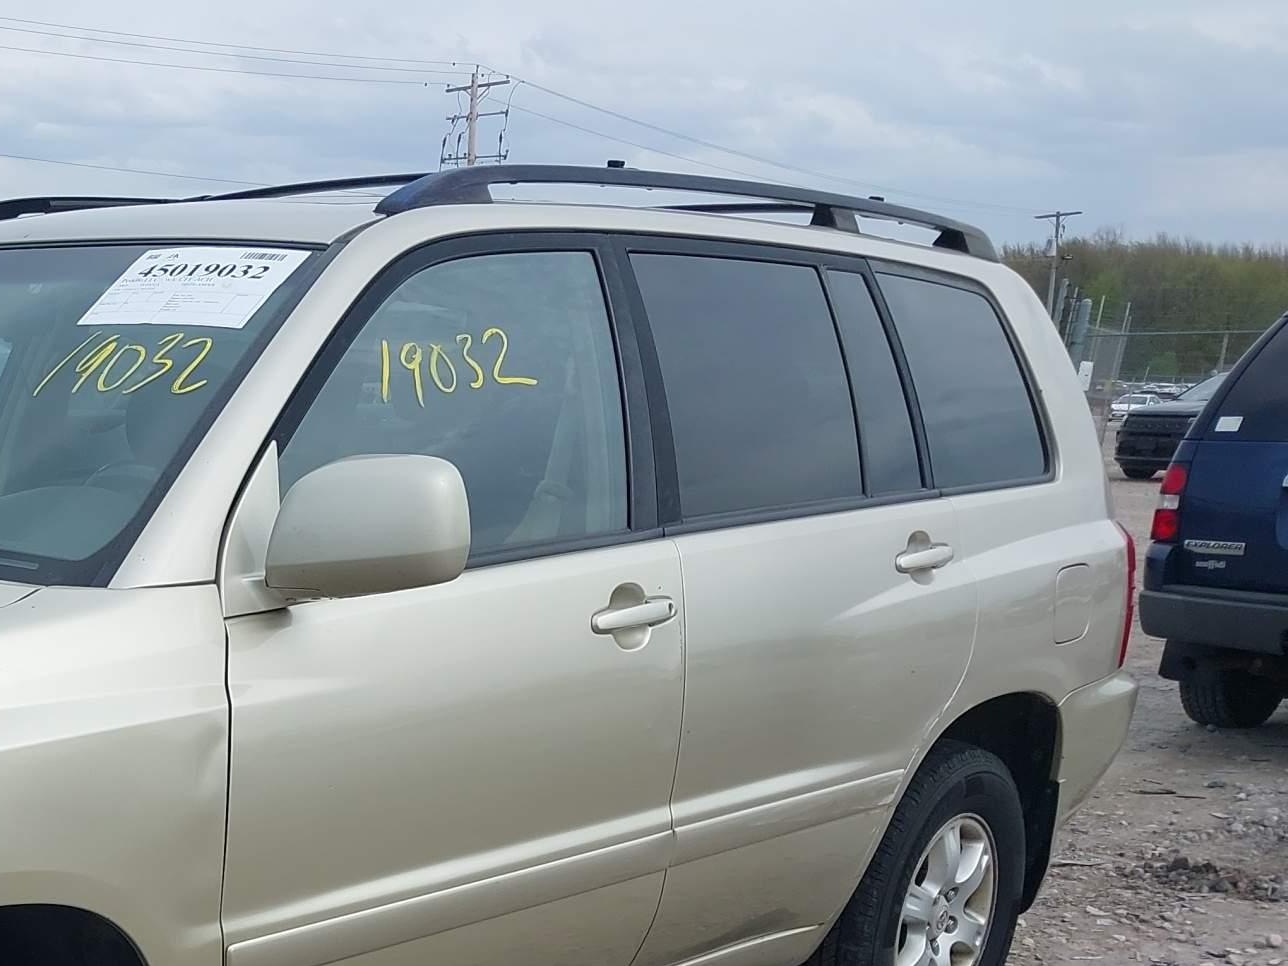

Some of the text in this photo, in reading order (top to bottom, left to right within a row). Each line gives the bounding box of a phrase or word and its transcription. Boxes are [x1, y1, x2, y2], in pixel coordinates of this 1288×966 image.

[137, 263, 272, 280] 45019032
[32, 331, 214, 397] 19032
[380, 327, 538, 407] 19032
[1185, 540, 1244, 552] EXPLORER
